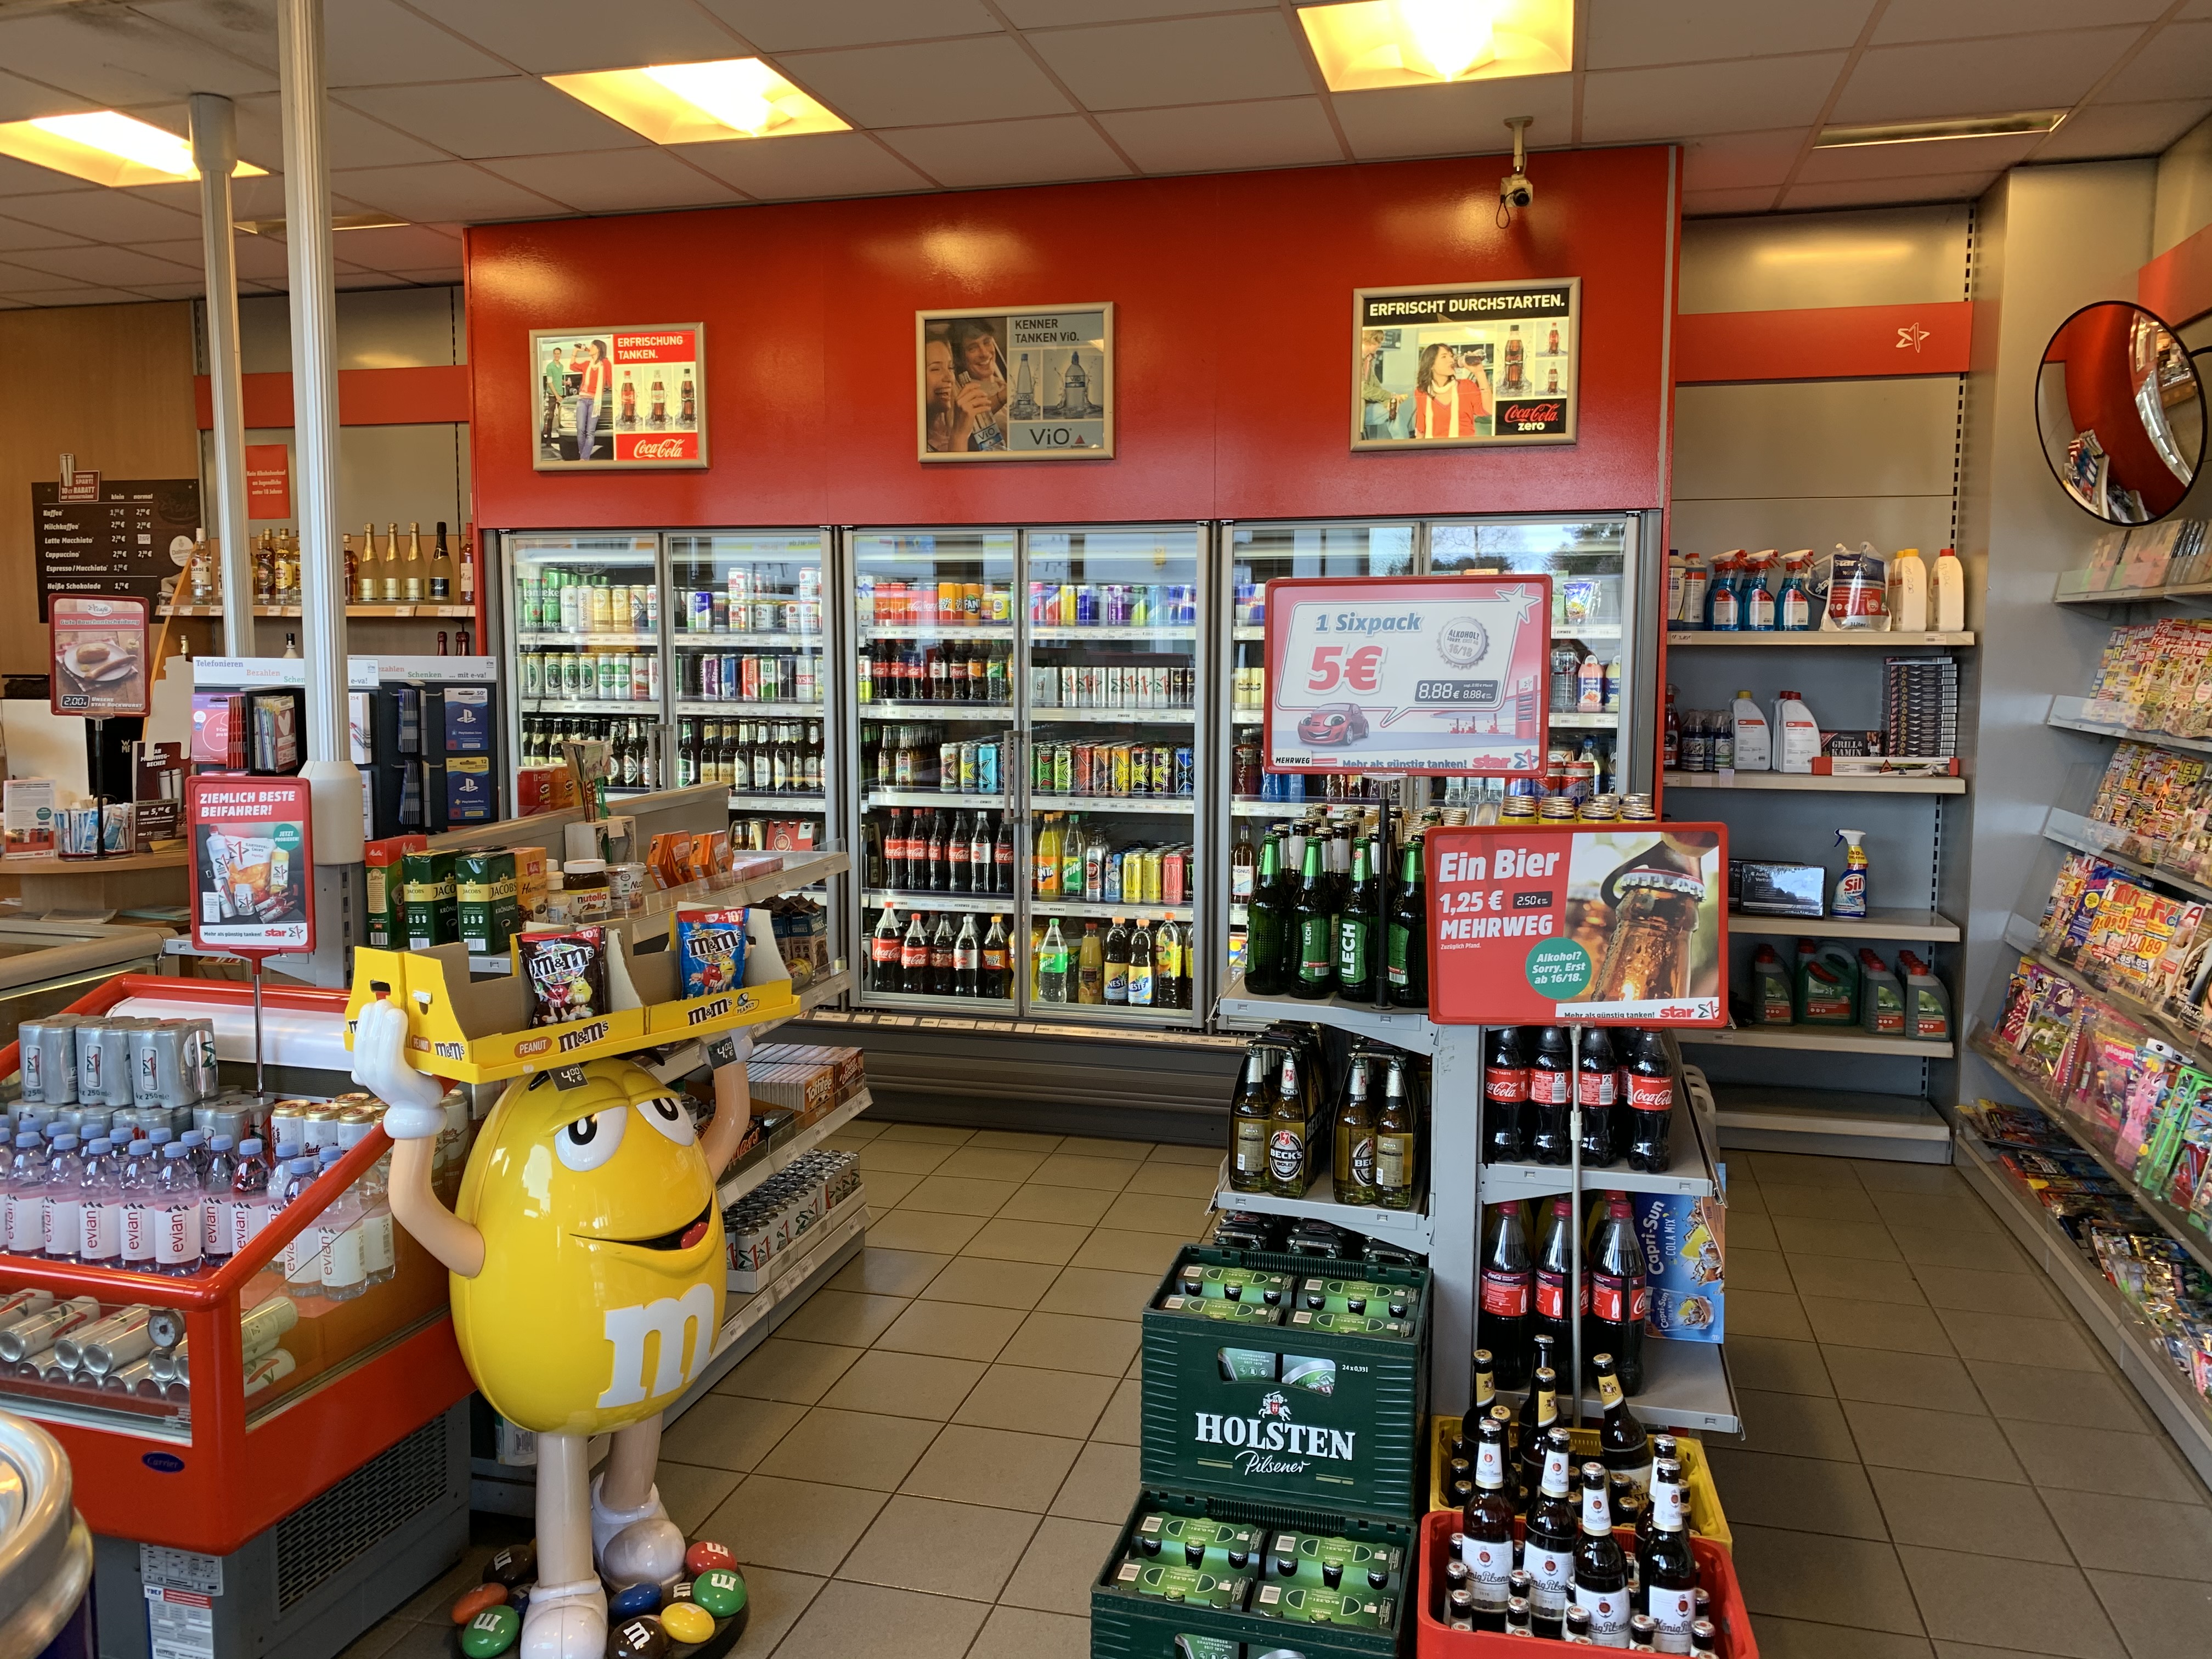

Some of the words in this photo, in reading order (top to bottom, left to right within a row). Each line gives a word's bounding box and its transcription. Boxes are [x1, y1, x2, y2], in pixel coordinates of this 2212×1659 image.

[1369, 300, 1446, 317] ERFRISCHT
[1449, 294, 1565, 312] DURCHSTARTEN.
[1015, 319, 1058, 330] KENNER
[617, 336, 684, 347] ERFRISCHUNG
[1015, 332, 1057, 343] TANKEN
[618, 349, 658, 360] TANKEN.
[1504, 403, 1561, 423] Coca-Cola
[1518, 422, 1545, 431] zero
[633, 439, 685, 458] Coca-Cola
[1835, 559, 1857, 567] star
[1316, 613, 1328, 631] 1
[1336, 612, 1423, 636] Sixpack
[1448, 629, 1479, 640] ALKOHOL?
[1832, 740, 1858, 749] GRILL
[1832, 748, 1863, 757] KAMIN
[1342, 759, 1368, 768] Mehr
[1370, 759, 1384, 768] als
[1387, 759, 1425, 768] günstig
[1427, 759, 1467, 768] tanken!
[1472, 754, 1511, 768] star
[200, 792, 256, 804] ZIEMLICH
[258, 791, 295, 803] BESTE
[201, 805, 272, 817] BEIFAHRER!
[1439, 851, 1487, 883] Ein
[1494, 848, 1560, 879] Bier
[433, 884, 456, 899] JACO
[490, 882, 517, 899] JACOBS
[1844, 878, 1863, 891] Sil
[577, 893, 607, 904] nutella
[1439, 891, 1483, 916] 1,25
[1488, 890, 1503, 911] €
[440, 905, 459, 914] KRÖNUN
[495, 905, 515, 914] KRÖNUNG
[264, 928, 287, 937] star
[1440, 915, 1553, 940] MEHRWEG
[1342, 923, 1356, 975] LECH
[1536, 951, 1582, 963] Alkohol?
[1532, 965, 1562, 974] Sorry.
[1565, 962, 1586, 972] Erst
[1108, 979, 1127, 988] NESTE
[1534, 975, 1548, 984] ab
[1550, 973, 1582, 984] 16/18.
[736, 1002, 755, 1014] PEANUT
[1660, 1006, 1694, 1018] star
[413, 1037, 429, 1051] PEANUT
[520, 1039, 548, 1054] PEANUT
[2105, 1043, 2134, 1062] playm
[806, 1074, 832, 1103] Toffifee
[1633, 1089, 1672, 1106] Coca-Cola
[1271, 1149, 1302, 1160] BECK'S
[88, 1210, 98, 1249] evian
[129, 1211, 139, 1251] evian
[208, 1206, 216, 1244] evian
[172, 1213, 184, 1254] evian
[1641, 1200, 1665, 1276] Capri-Sun
[1664, 1237, 1676, 1256] COLA
[323, 1234, 333, 1276] evian
[1660, 1291, 1669, 1329] Capri-Sun
[1195, 1412, 1356, 1461] HOLSTEN
[147, 1455, 179, 1469] Carrier
[1235, 1451, 1311, 1476] Pilsener
[1654, 1618, 1680, 1634] König
